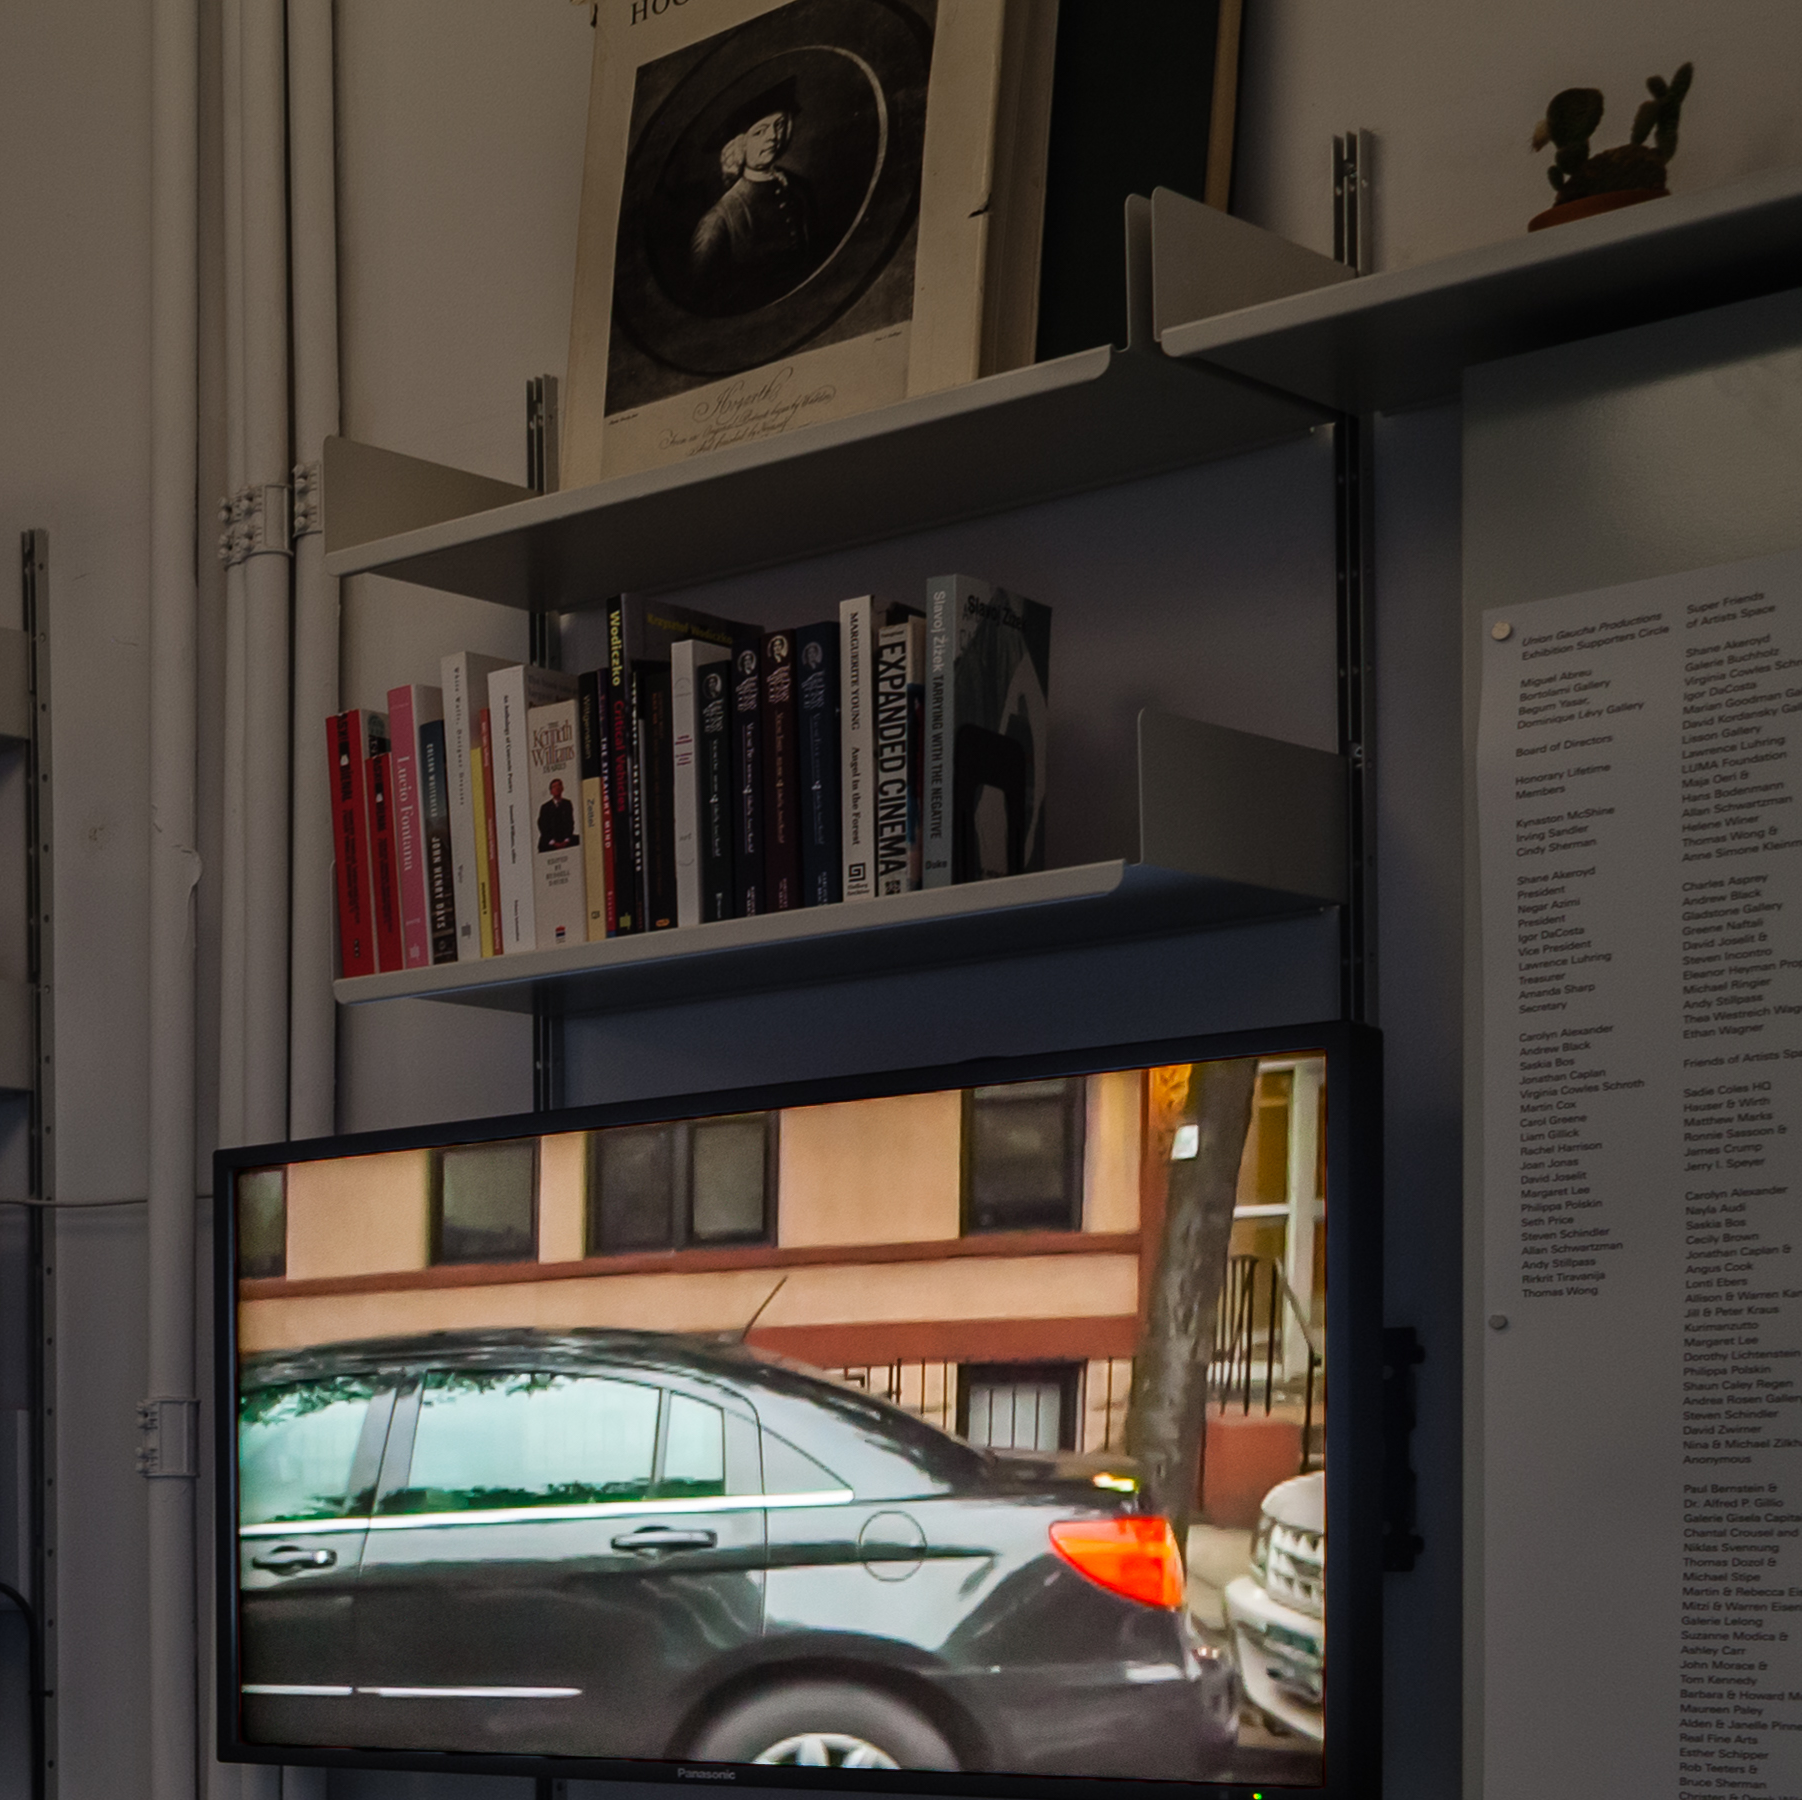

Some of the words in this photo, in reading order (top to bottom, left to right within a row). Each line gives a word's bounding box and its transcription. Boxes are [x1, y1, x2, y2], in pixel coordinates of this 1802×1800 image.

[933, 591, 946, 633] Slavoj
[609, 610, 622, 687] Wodiczko
[850, 611, 860, 693] MARGUERITE
[613, 700, 624, 744] Critical
[851, 696, 861, 731] YOUNG
[877, 640, 906, 774] EXPANDED
[933, 675, 944, 732] TARRYING
[851, 746, 860, 776] Angel
[931, 759, 942, 780] THE
[932, 734, 943, 757] WITH
[397, 756, 410, 805] Lucio
[616, 748, 626, 812] Vehicles
[851, 813, 861, 846] Forest
[877, 776, 907, 876] CINEMA
[930, 782, 942, 840] NEGATIVE
[399, 808, 413, 872] Fontana
